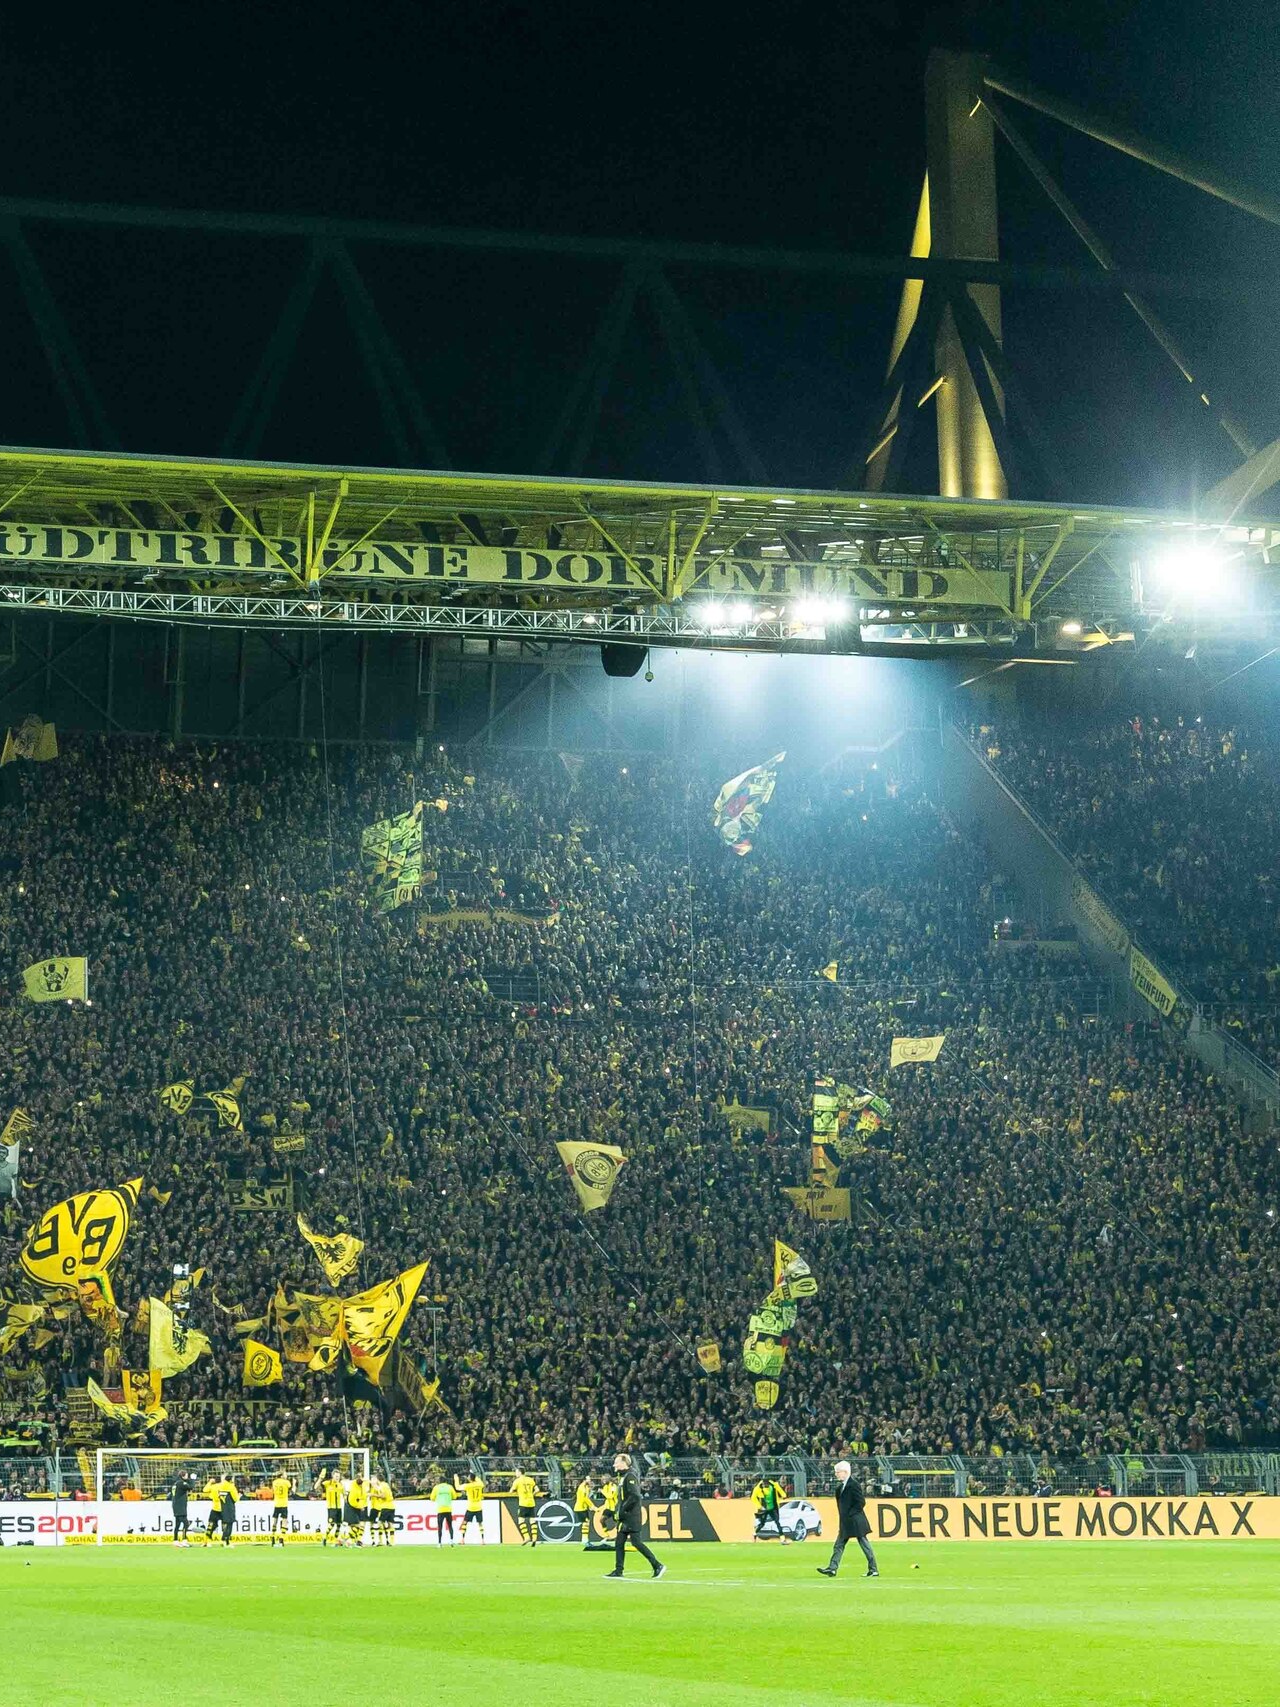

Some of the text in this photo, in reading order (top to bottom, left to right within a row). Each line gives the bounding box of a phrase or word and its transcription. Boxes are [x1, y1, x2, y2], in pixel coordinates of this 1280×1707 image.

[501, 550, 949, 600] DORTMUND
[151, 1515, 203, 1532] Jezt
[877, 1500, 1257, 1538] DER NEUE MOKKA X
